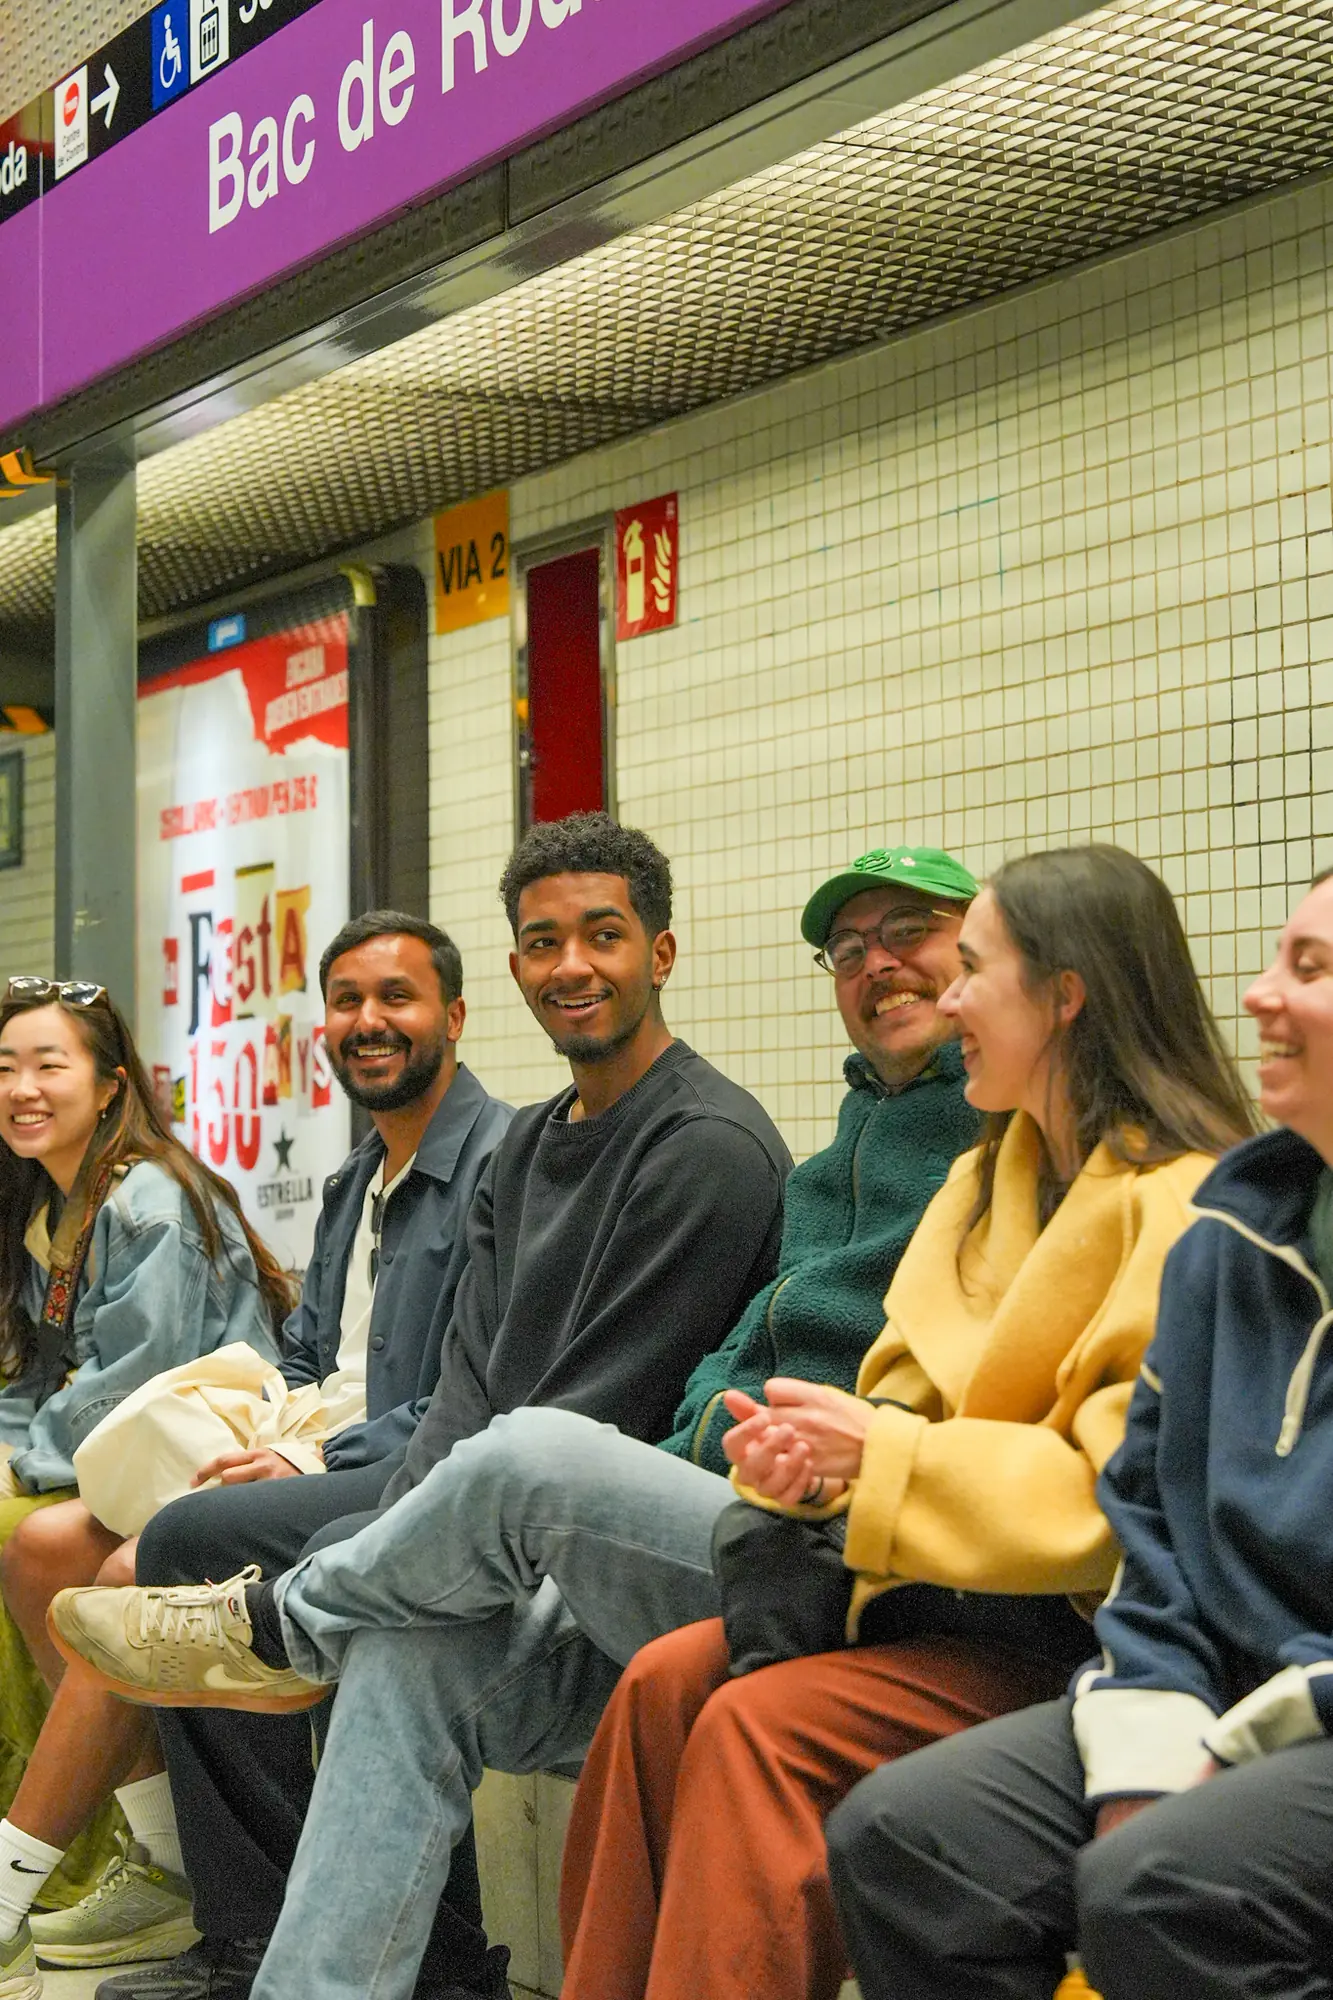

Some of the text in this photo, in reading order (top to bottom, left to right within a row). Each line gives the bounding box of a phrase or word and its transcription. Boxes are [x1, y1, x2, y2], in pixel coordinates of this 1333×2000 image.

[208, 0, 583, 234] Bac de Ro
[0, 140, 27, 195] da
[438, 531, 505, 595] VIA 2
[188, 1039, 262, 1171] 150
[257, 1177, 313, 1208] ESTRELLA
